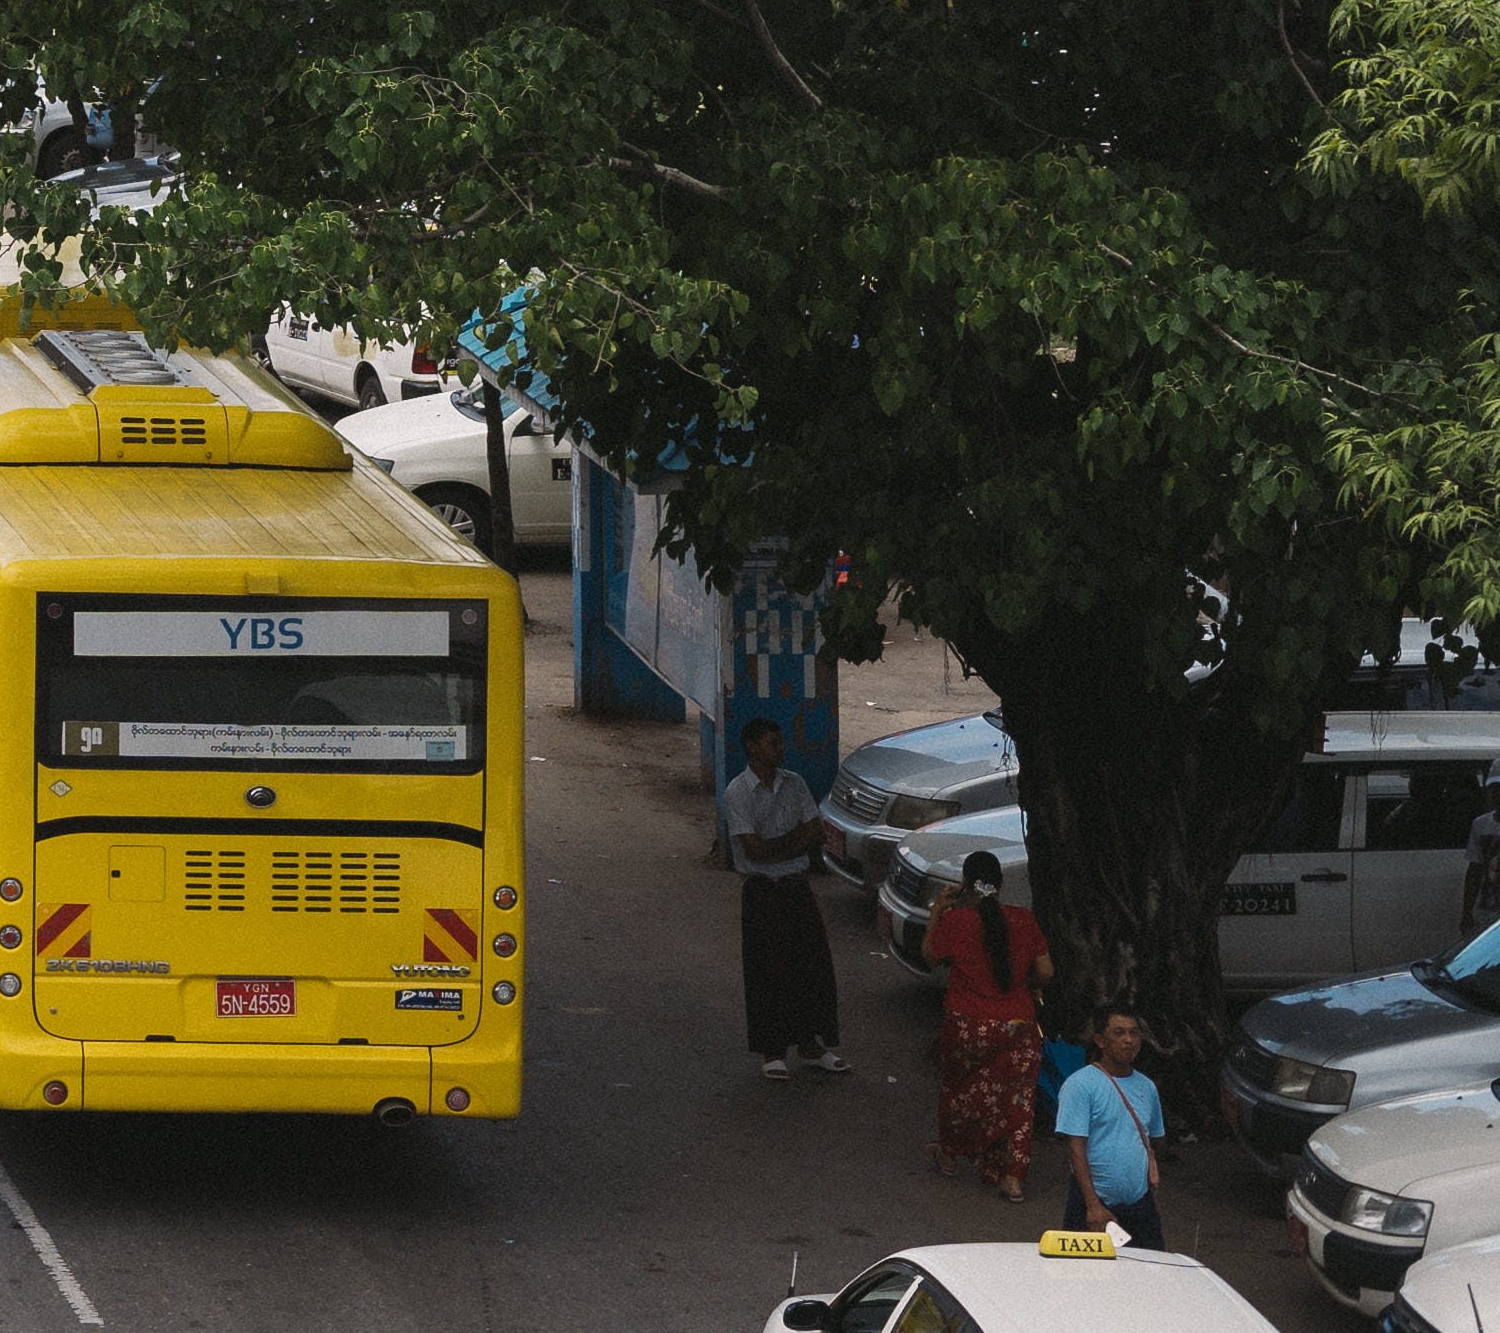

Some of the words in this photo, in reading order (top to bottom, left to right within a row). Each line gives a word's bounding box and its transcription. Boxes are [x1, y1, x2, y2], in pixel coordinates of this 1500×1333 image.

[219, 618, 304, 650] YBS
[390, 964, 471, 978] YUTONG
[244, 984, 269, 993] YGN
[418, 991, 460, 999] MAXIMA
[221, 994, 291, 1015] 5N-4559
[1058, 1238, 1104, 1252] TAXI
